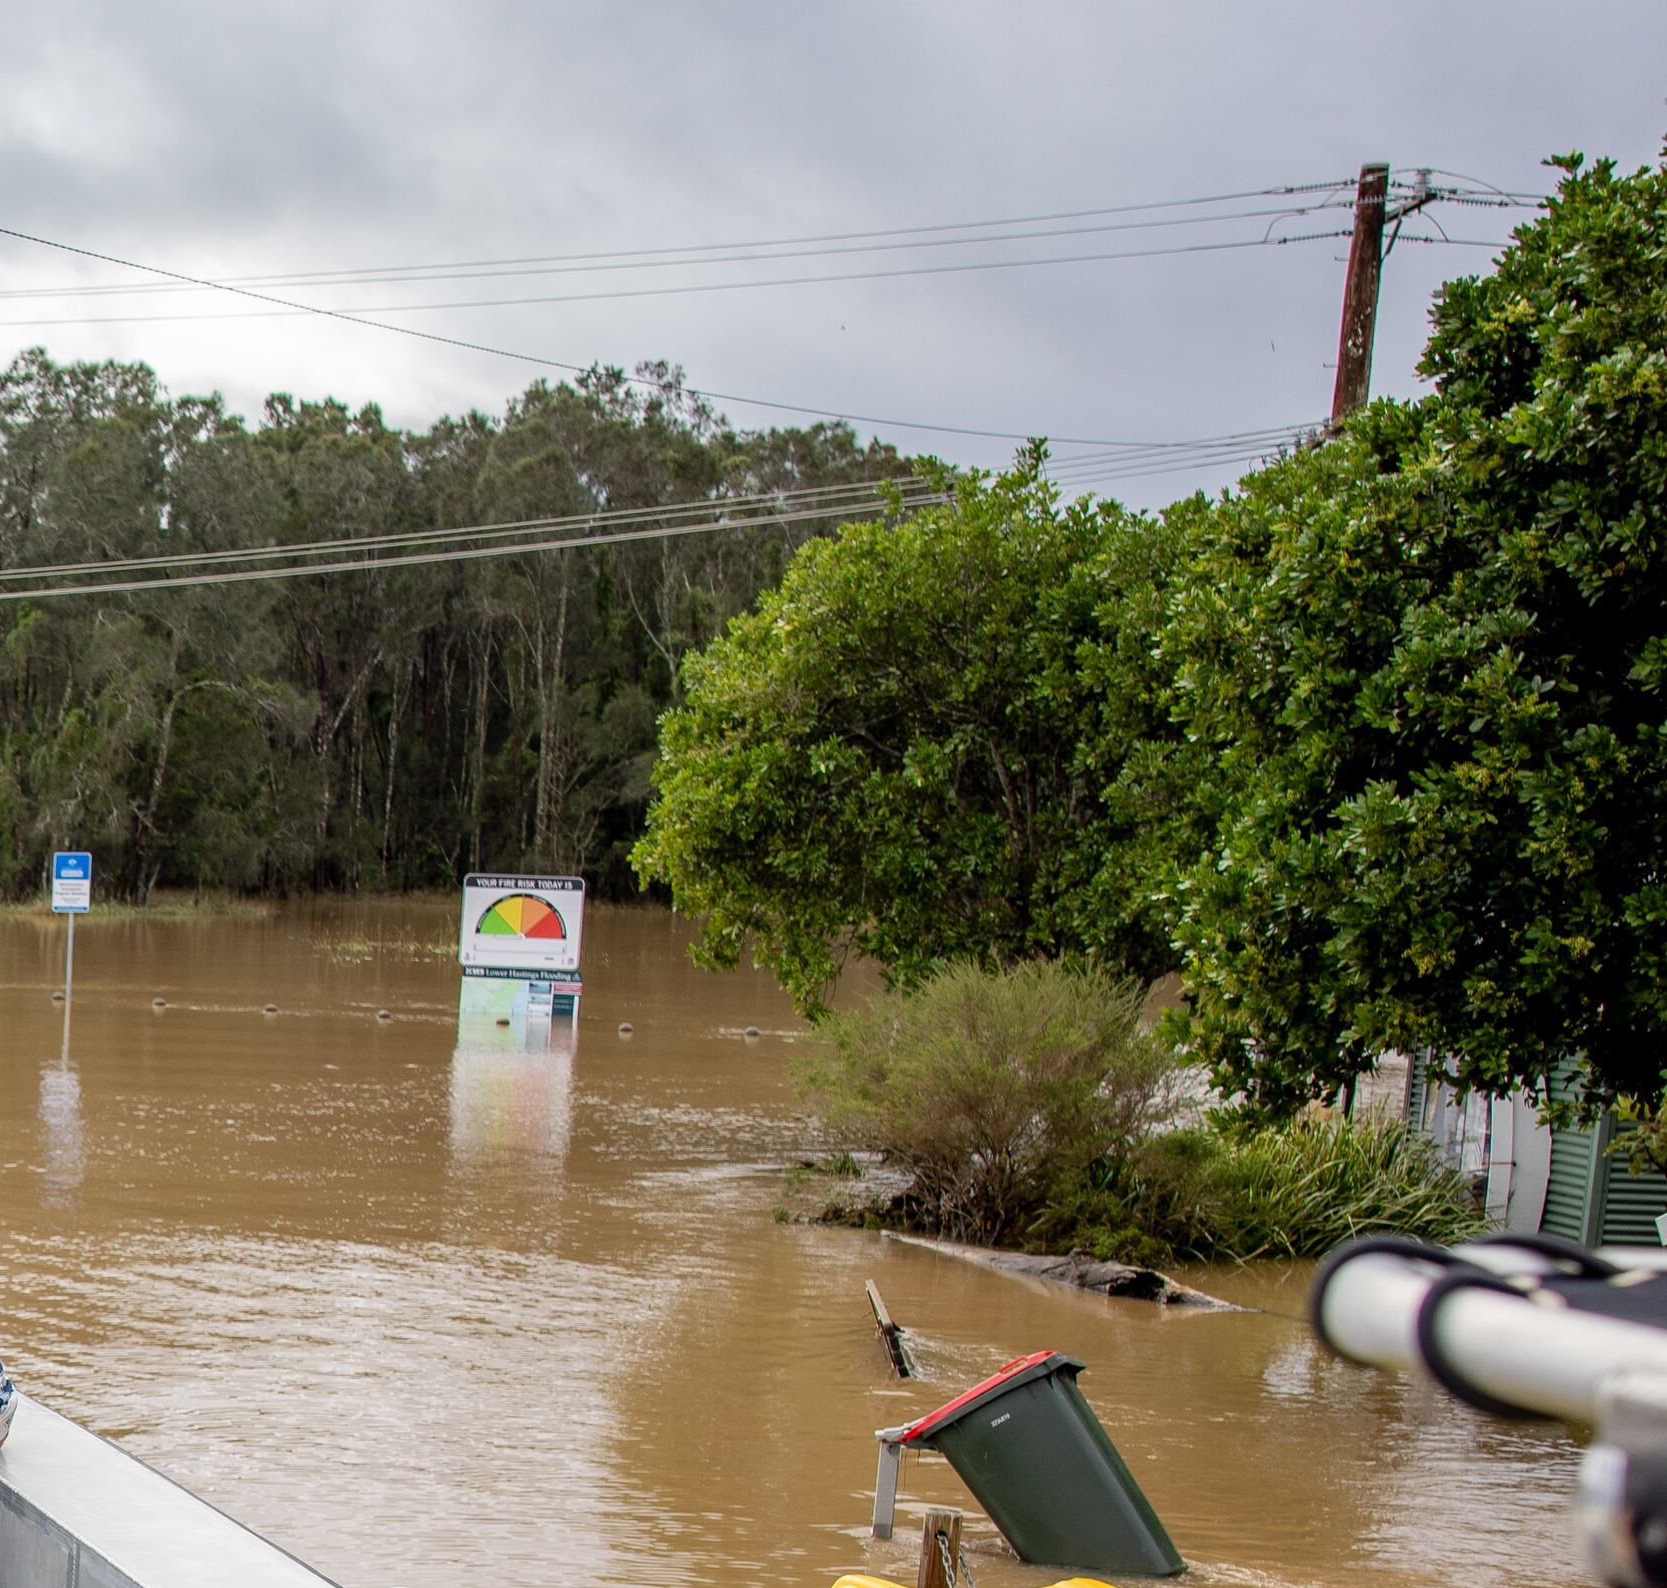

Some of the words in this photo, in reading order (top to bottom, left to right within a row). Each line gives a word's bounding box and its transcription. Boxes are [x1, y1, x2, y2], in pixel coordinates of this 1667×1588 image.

[476, 879, 497, 887] YOUR
[498, 879, 516, 888] FIRE
[517, 880, 535, 889] RISK
[538, 881, 564, 890] TODAY
[565, 882, 573, 890] IS
